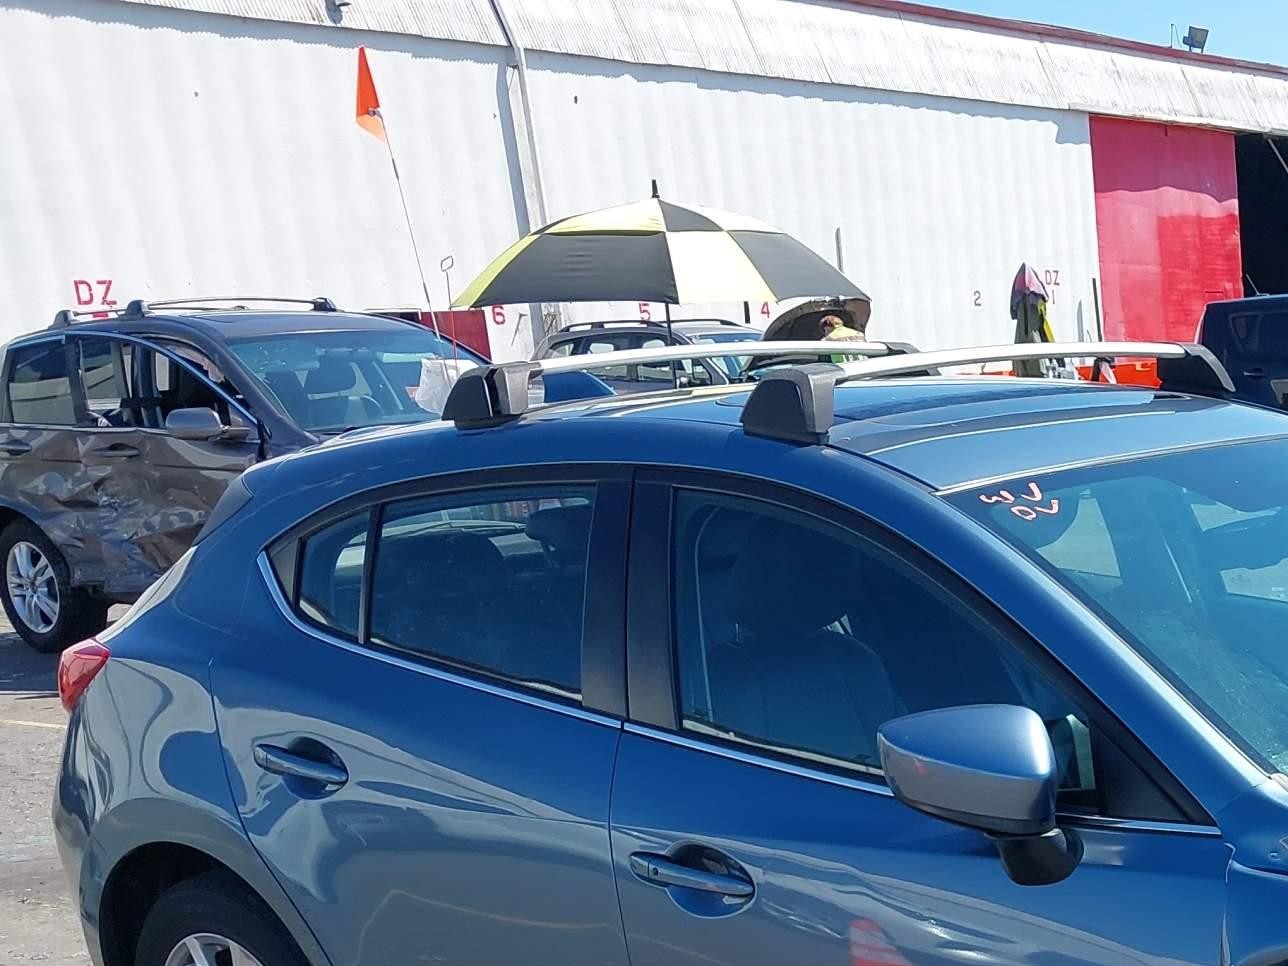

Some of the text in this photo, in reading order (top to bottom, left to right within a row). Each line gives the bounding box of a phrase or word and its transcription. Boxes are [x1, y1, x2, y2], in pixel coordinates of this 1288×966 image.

[1045, 269, 1061, 286] DZ
[73, 279, 118, 306] DZ
[973, 290, 982, 307] 2
[491, 303, 506, 326] 6
[637, 302, 651, 323] 5
[760, 301, 770, 319] 4
